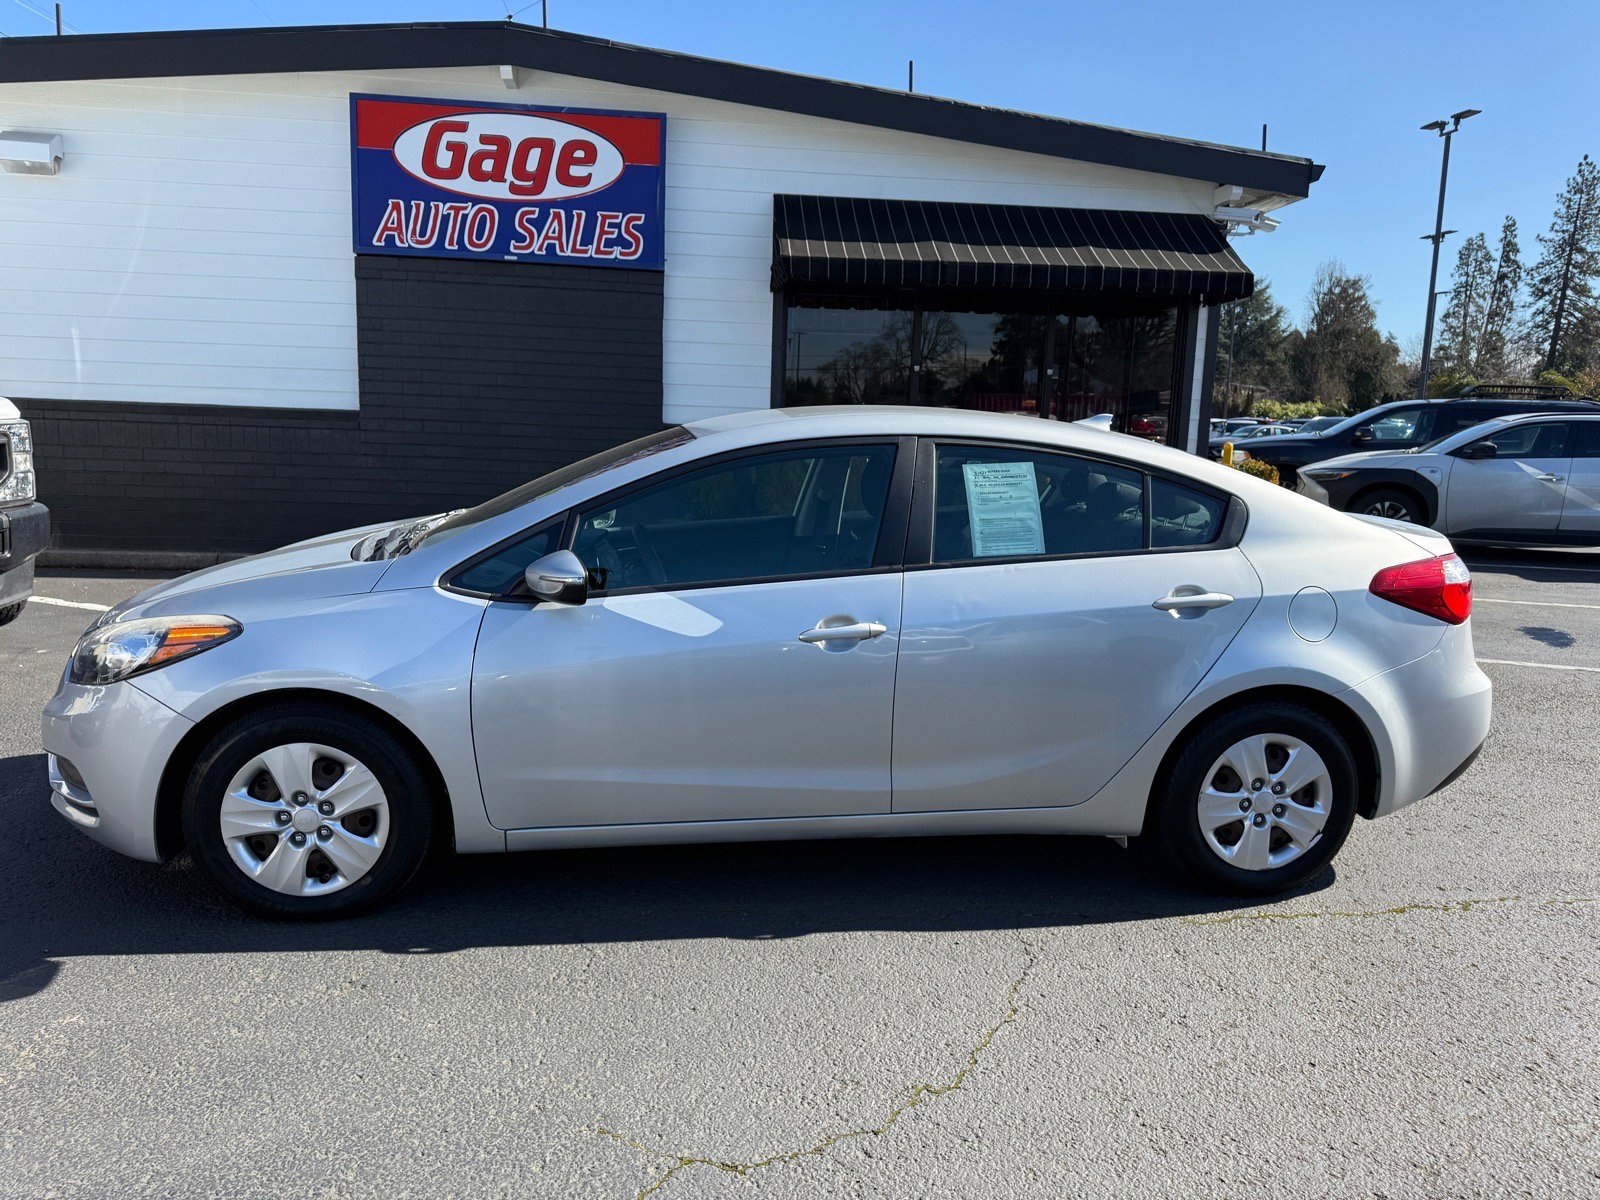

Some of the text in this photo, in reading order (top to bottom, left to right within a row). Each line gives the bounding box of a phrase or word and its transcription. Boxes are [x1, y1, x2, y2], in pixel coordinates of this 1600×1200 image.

[422, 120, 598, 196] Gage
[372, 199, 645, 260] AUTO SALES
